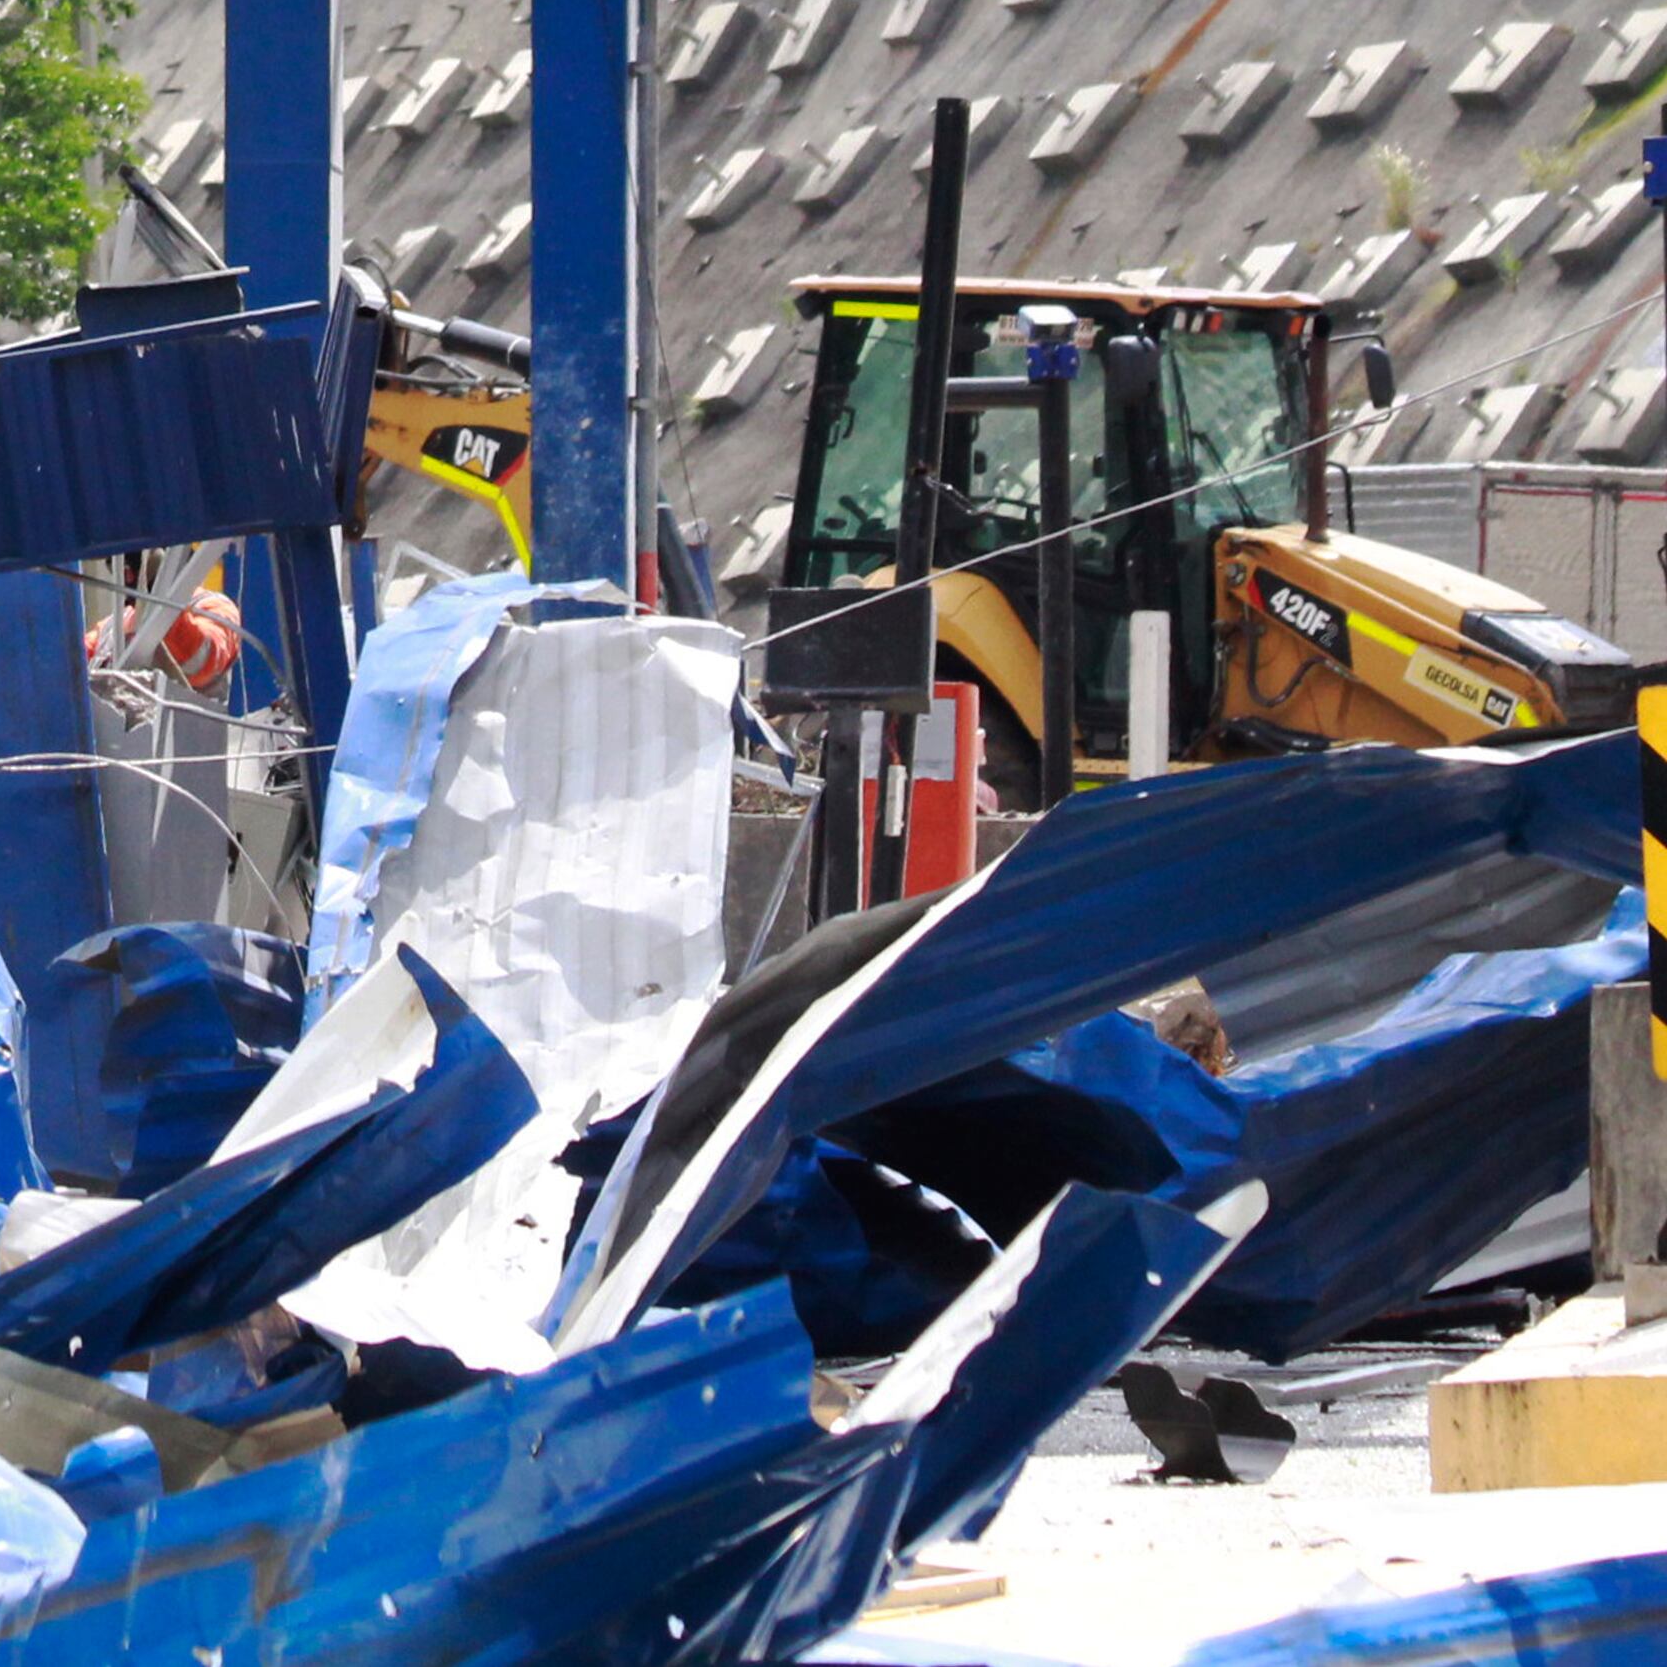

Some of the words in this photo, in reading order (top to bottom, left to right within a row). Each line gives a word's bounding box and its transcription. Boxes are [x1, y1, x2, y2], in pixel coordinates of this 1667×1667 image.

[454, 427, 501, 478] CAT
[1425, 665, 1480, 703] GECOLSA
[1485, 696, 1510, 717] CAT
